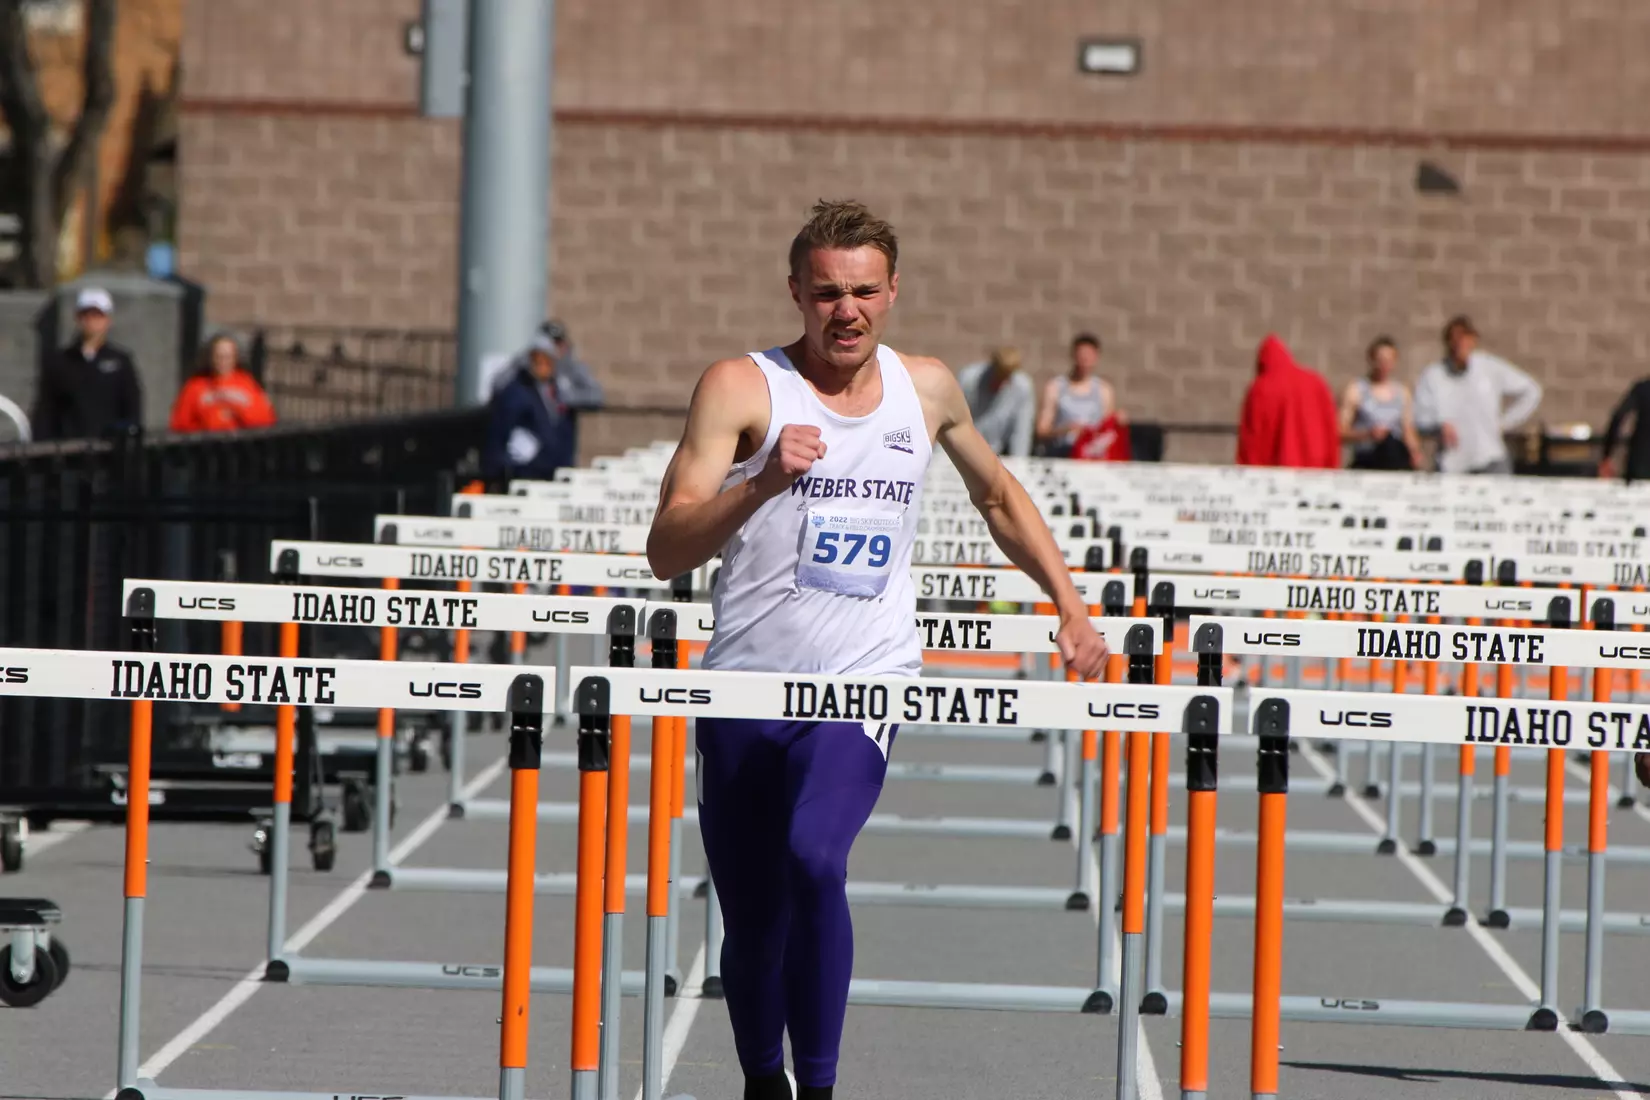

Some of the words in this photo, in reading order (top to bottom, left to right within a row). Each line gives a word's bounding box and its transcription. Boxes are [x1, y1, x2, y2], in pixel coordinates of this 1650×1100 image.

[791, 476, 857, 499] WEBER
[861, 480, 915, 505] STATE
[829, 516, 848, 524] 2022
[499, 526, 555, 550] IDAHO
[560, 528, 620, 552] STATE
[1262, 530, 1316, 549] STATE
[812, 531, 891, 568] 579
[931, 541, 992, 564] STATE
[1585, 542, 1640, 558] STATE
[316, 556, 364, 568] UCS
[410, 552, 479, 579] IDAHO
[488, 557, 563, 582] STATE
[1248, 551, 1304, 573] IDAHO
[1310, 554, 1369, 577] STATE
[606, 567, 653, 580] UCS
[921, 573, 996, 599] STATE
[1193, 588, 1241, 600] UCS
[178, 596, 236, 611] UCS
[1286, 585, 1355, 611] IDAHO
[1365, 587, 1440, 614] STATE
[1485, 599, 1532, 611] UCS
[292, 592, 375, 624] IDAHO
[387, 597, 478, 628] STATE
[532, 609, 589, 624] UCS
[1243, 632, 1301, 646] UCS
[1356, 628, 1441, 660] IDAHO
[1452, 631, 1544, 664] STATE
[111, 660, 212, 701] IDAHO
[226, 664, 336, 705] STATE
[409, 681, 483, 699] UCS
[639, 687, 712, 705] UCS
[783, 681, 888, 721] IDAHO
[903, 685, 1018, 725] STATE
[1088, 702, 1161, 719] UCS
[1320, 709, 1393, 728] UCS
[1465, 705, 1572, 746] IDAHO
[111, 790, 165, 805] US
[442, 964, 500, 978] UCS
[1320, 998, 1379, 1011] UCS
